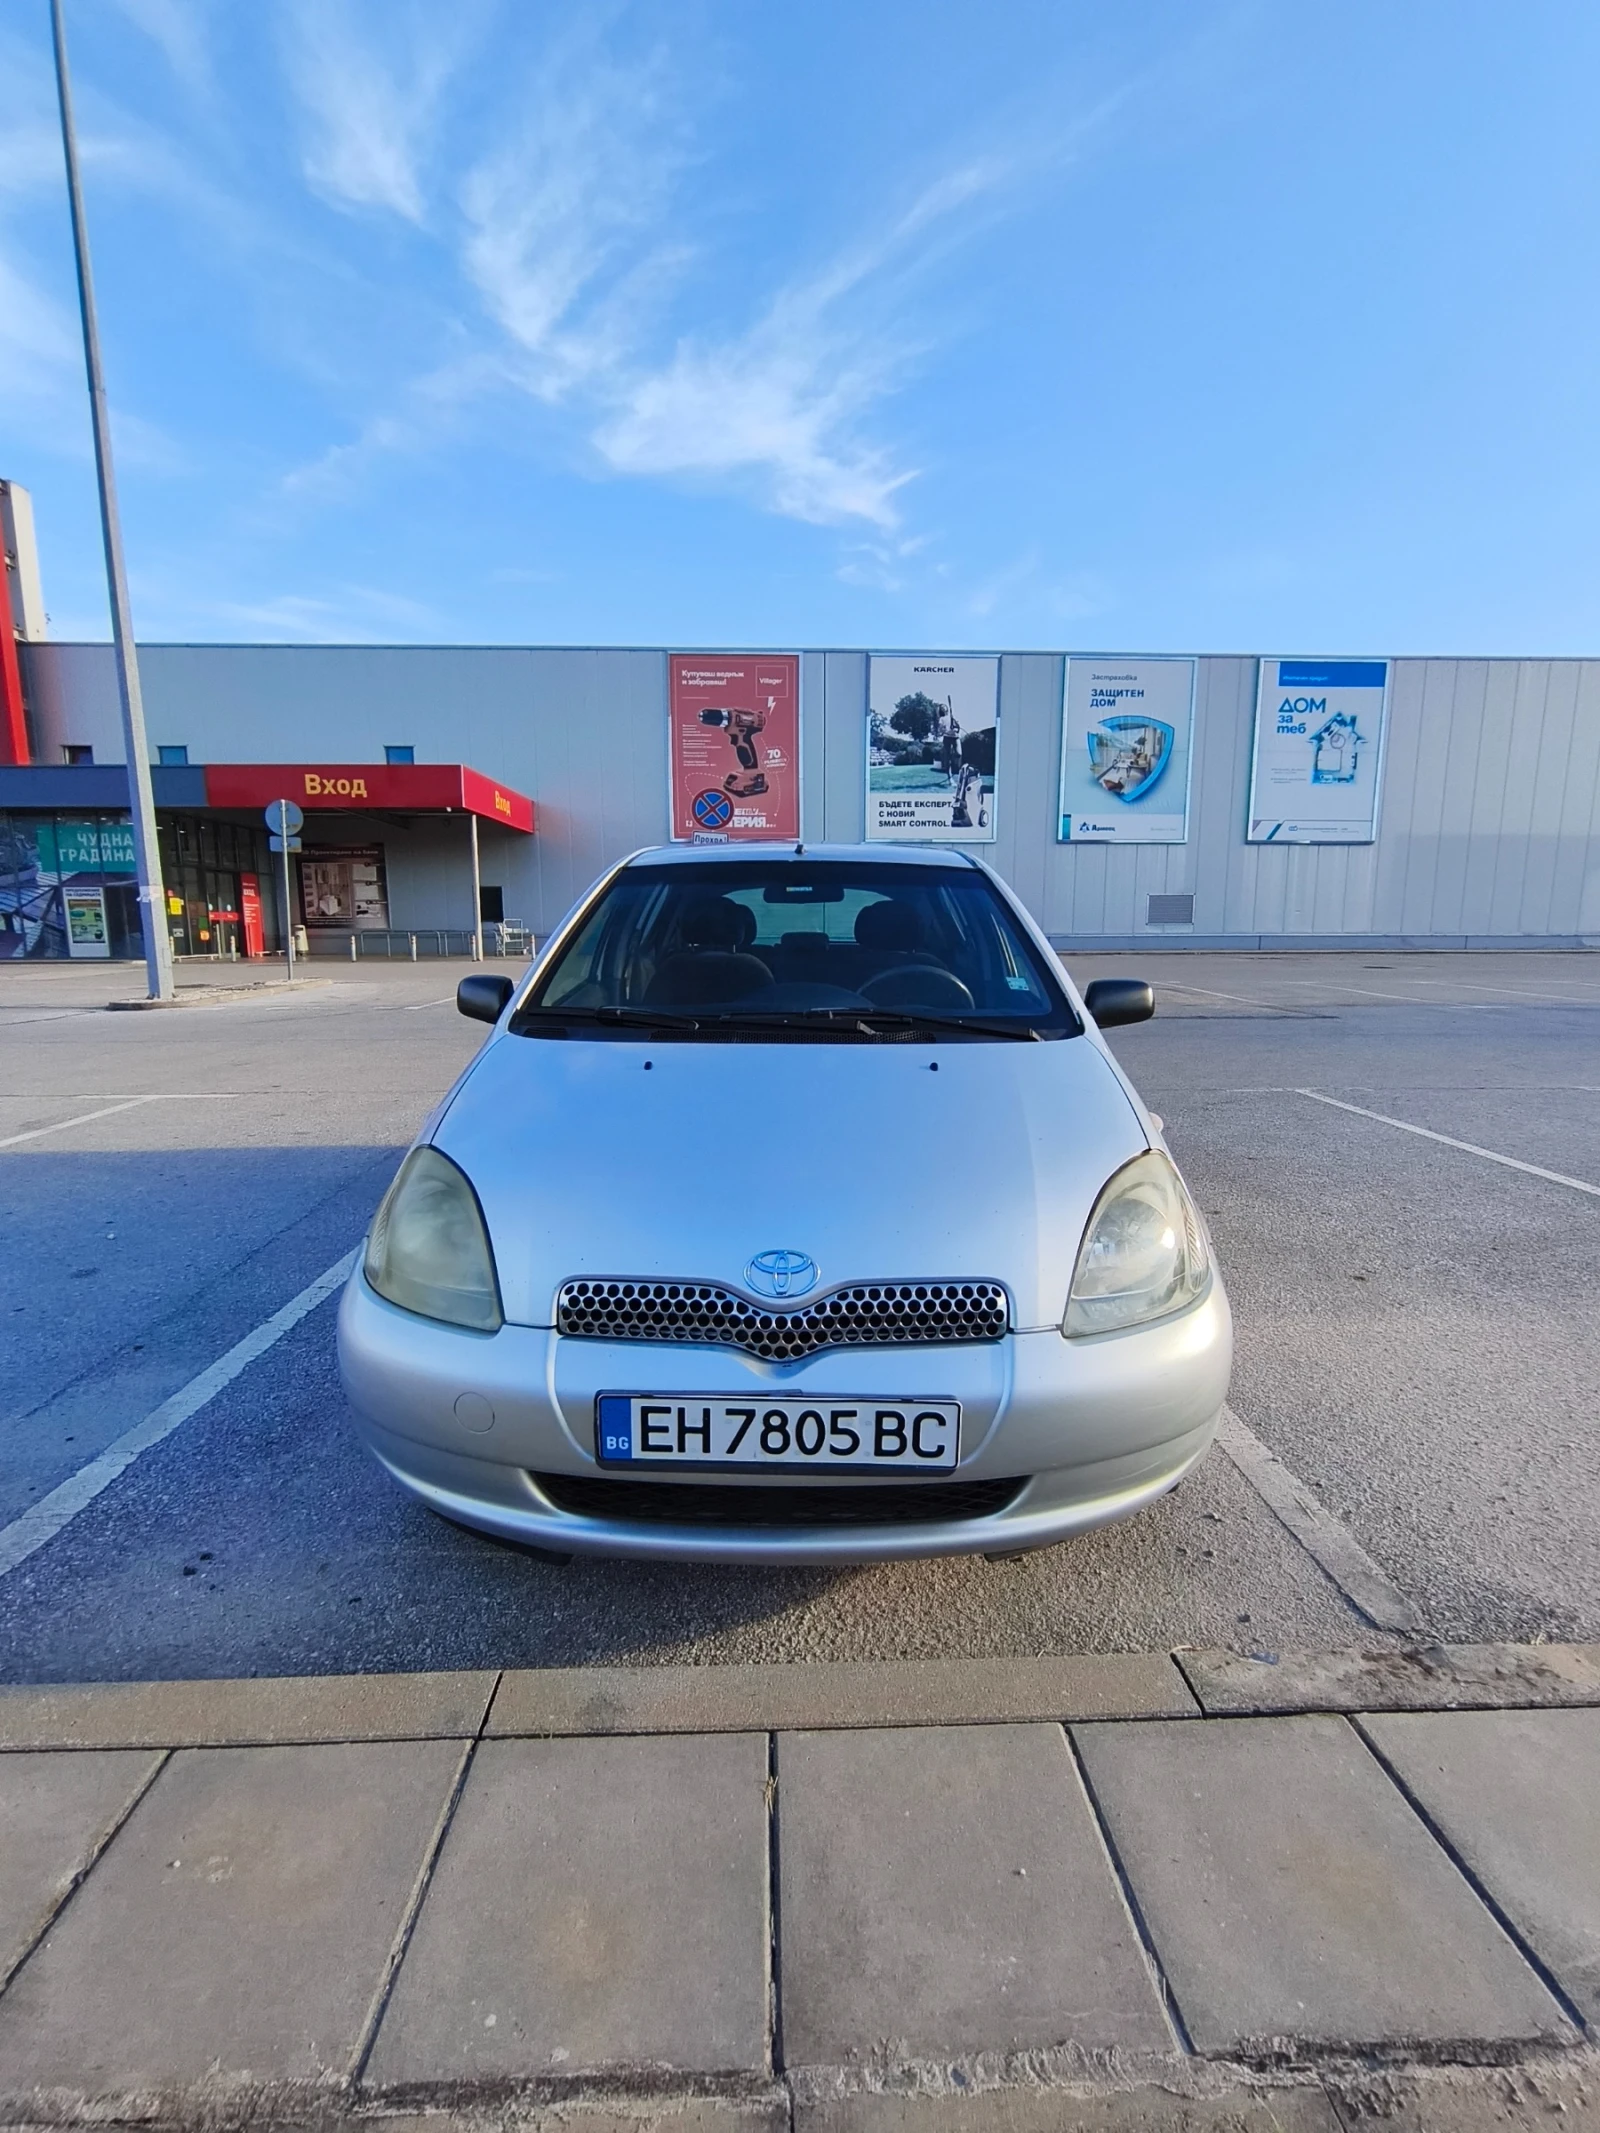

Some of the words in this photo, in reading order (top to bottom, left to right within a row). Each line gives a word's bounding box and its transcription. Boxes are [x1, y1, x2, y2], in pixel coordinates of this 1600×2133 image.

[1091, 689, 1145, 698] ЗАЩИТЕН
[1090, 698, 1117, 708] ДОМ
[1278, 697, 1327, 713] ДОМ
[1278, 715, 1293, 723] за
[1277, 722, 1306, 734] теб
[767, 749, 781, 758] 70
[304, 774, 368, 798] Вход
[494, 791, 511, 817] Вход
[77, 833, 134, 847] ЧУДНА
[59, 849, 135, 864] ГРАДИНА
[605, 1436, 629, 1450] BG
[640, 1406, 711, 1454] EH
[724, 1408, 861, 1456] 7805
[873, 1410, 947, 1459] BC
